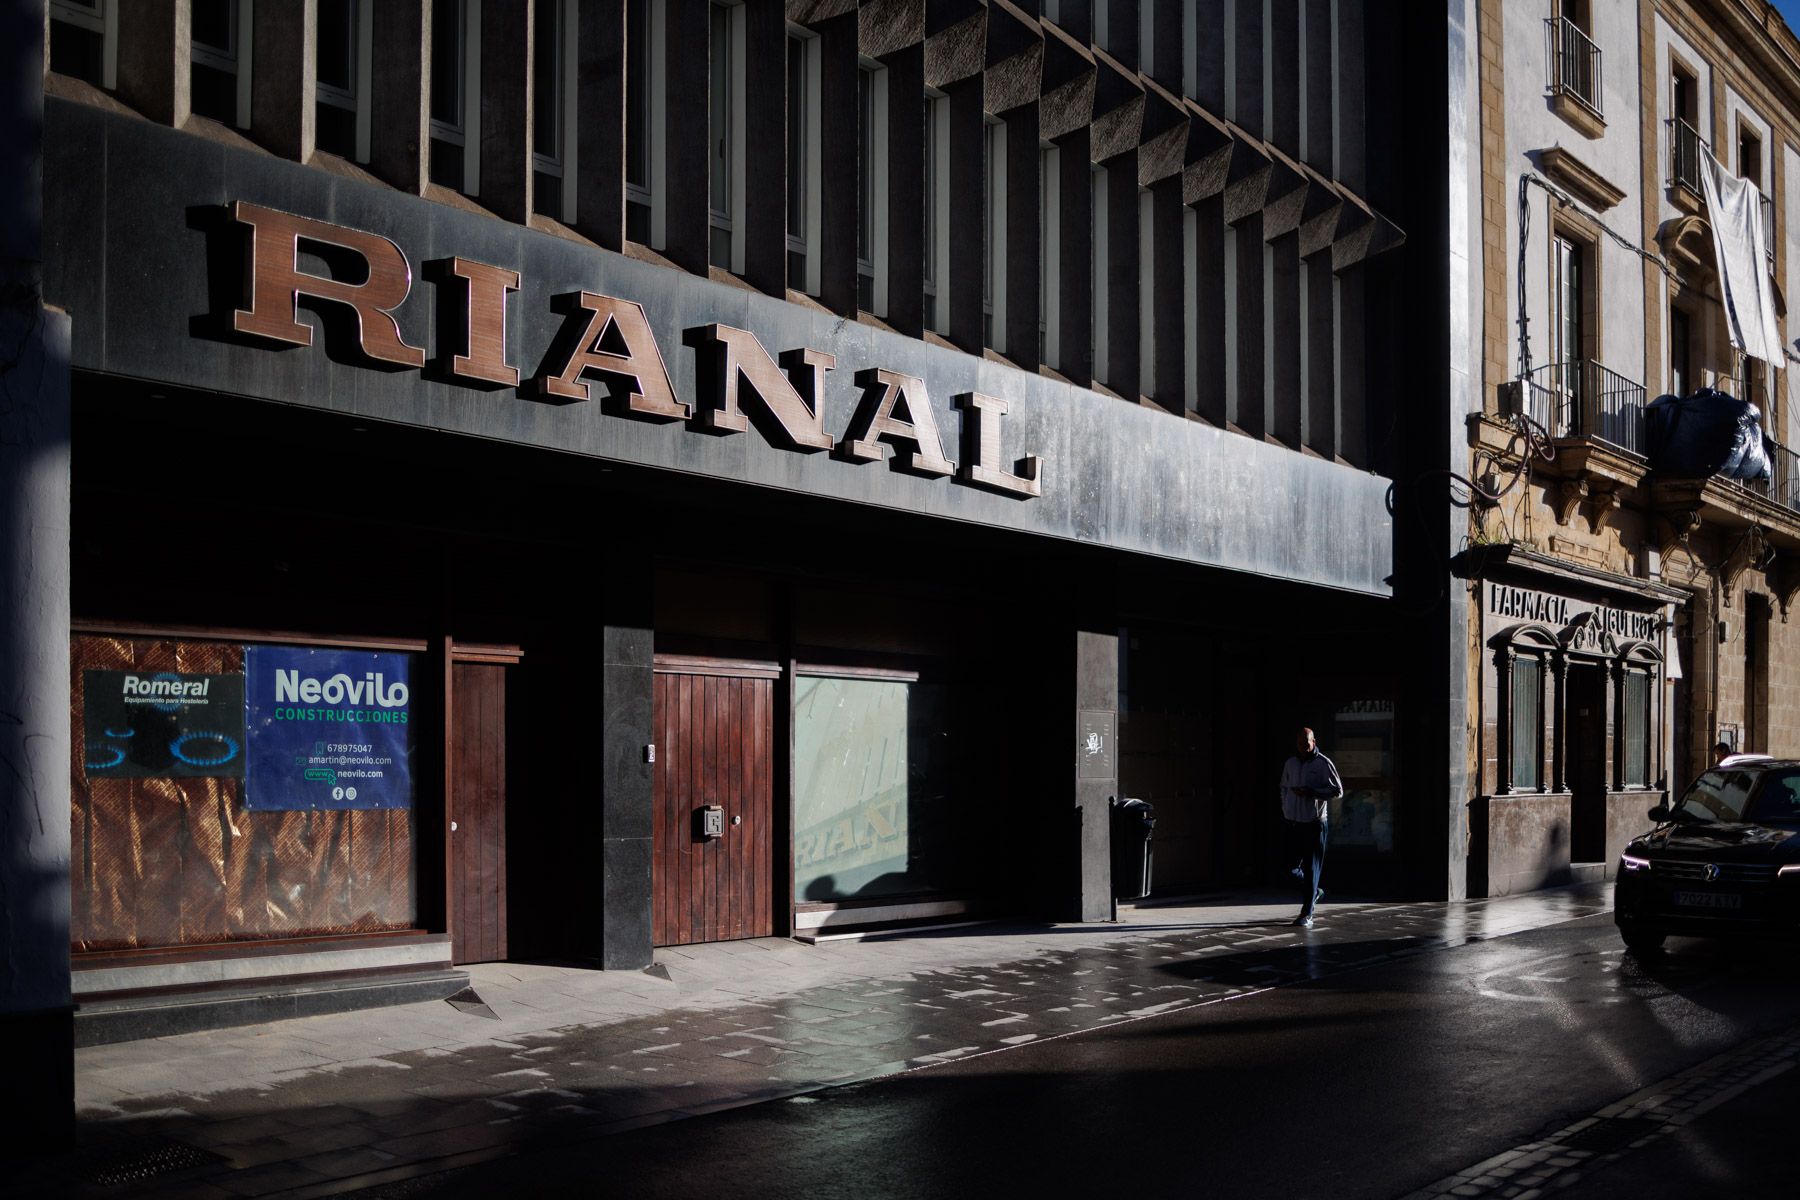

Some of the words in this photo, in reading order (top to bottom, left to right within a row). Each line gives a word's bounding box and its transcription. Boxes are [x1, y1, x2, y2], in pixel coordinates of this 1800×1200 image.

[232, 200, 1044, 499] RIANAL
[1493, 584, 1570, 626] FARMACIA
[122, 675, 210, 696] Romeral
[275, 669, 409, 707] Neovilo
[275, 707, 408, 724] CONSTRUCCIONES
[327, 744, 373, 753] 678975047
[308, 756, 392, 766] amartin@neovilo.com
[337, 769, 383, 778] neovilo.com
[797, 799, 906, 867] RIAN
